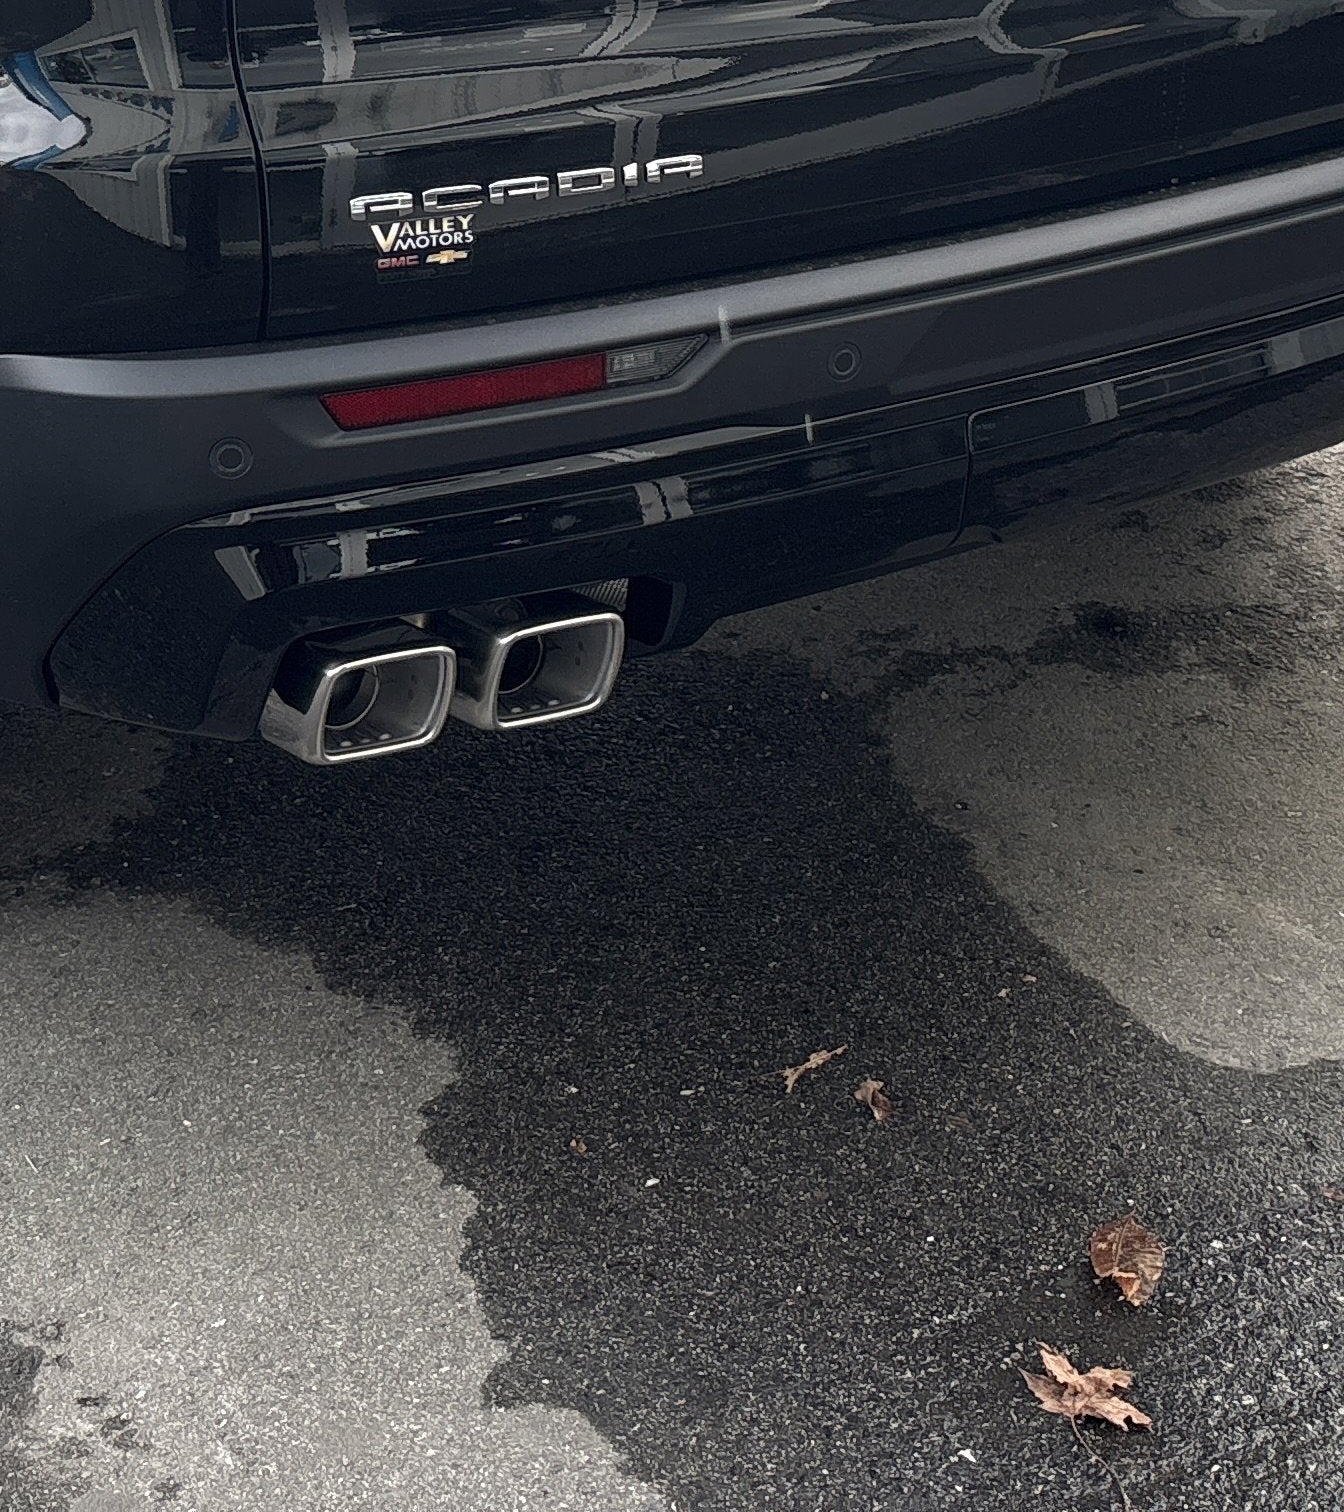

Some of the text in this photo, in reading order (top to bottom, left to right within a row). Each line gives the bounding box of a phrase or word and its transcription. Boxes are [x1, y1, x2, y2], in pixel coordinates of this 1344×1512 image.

[349, 154, 704, 222] ACADIA
[370, 213, 475, 253] VALLEY
[393, 229, 475, 252] MOTORS
[377, 254, 420, 269] GMC
